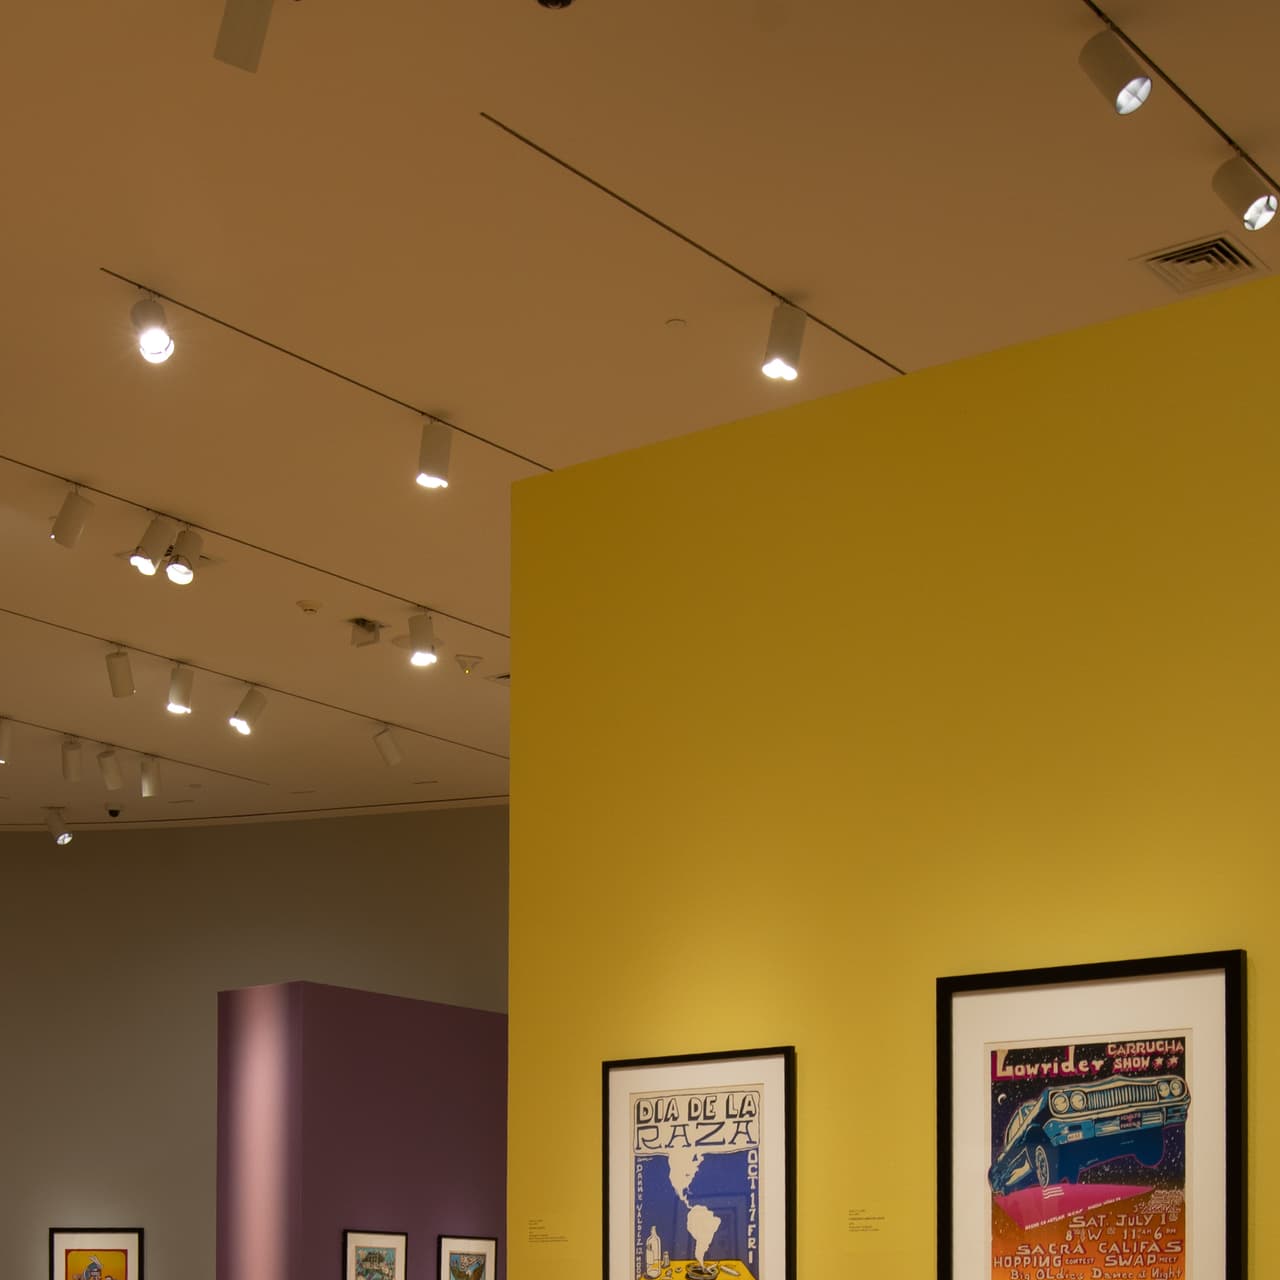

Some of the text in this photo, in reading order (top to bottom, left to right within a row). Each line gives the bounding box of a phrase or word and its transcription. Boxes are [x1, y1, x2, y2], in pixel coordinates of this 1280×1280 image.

[1106, 1040, 1185, 1057] CARRUCHA
[995, 1045, 1104, 1079] Lowrider
[1113, 1056, 1150, 1072] SHOW
[636, 1093, 757, 1124] DIA DE LA
[635, 1120, 757, 1150] RAZA
[747, 1149, 758, 1264] OCT 17 FRI
[1070, 1214, 1109, 1228] SAT.
[1116, 1213, 1152, 1227] JULY
[1016, 1241, 1182, 1255] SACRA CALIFAS
[993, 1255, 1062, 1268] HOPPING
[1104, 1254, 1157, 1267] SWAP
[1091, 1267, 1135, 1280] Dance
[1150, 1267, 1183, 1280] Night
